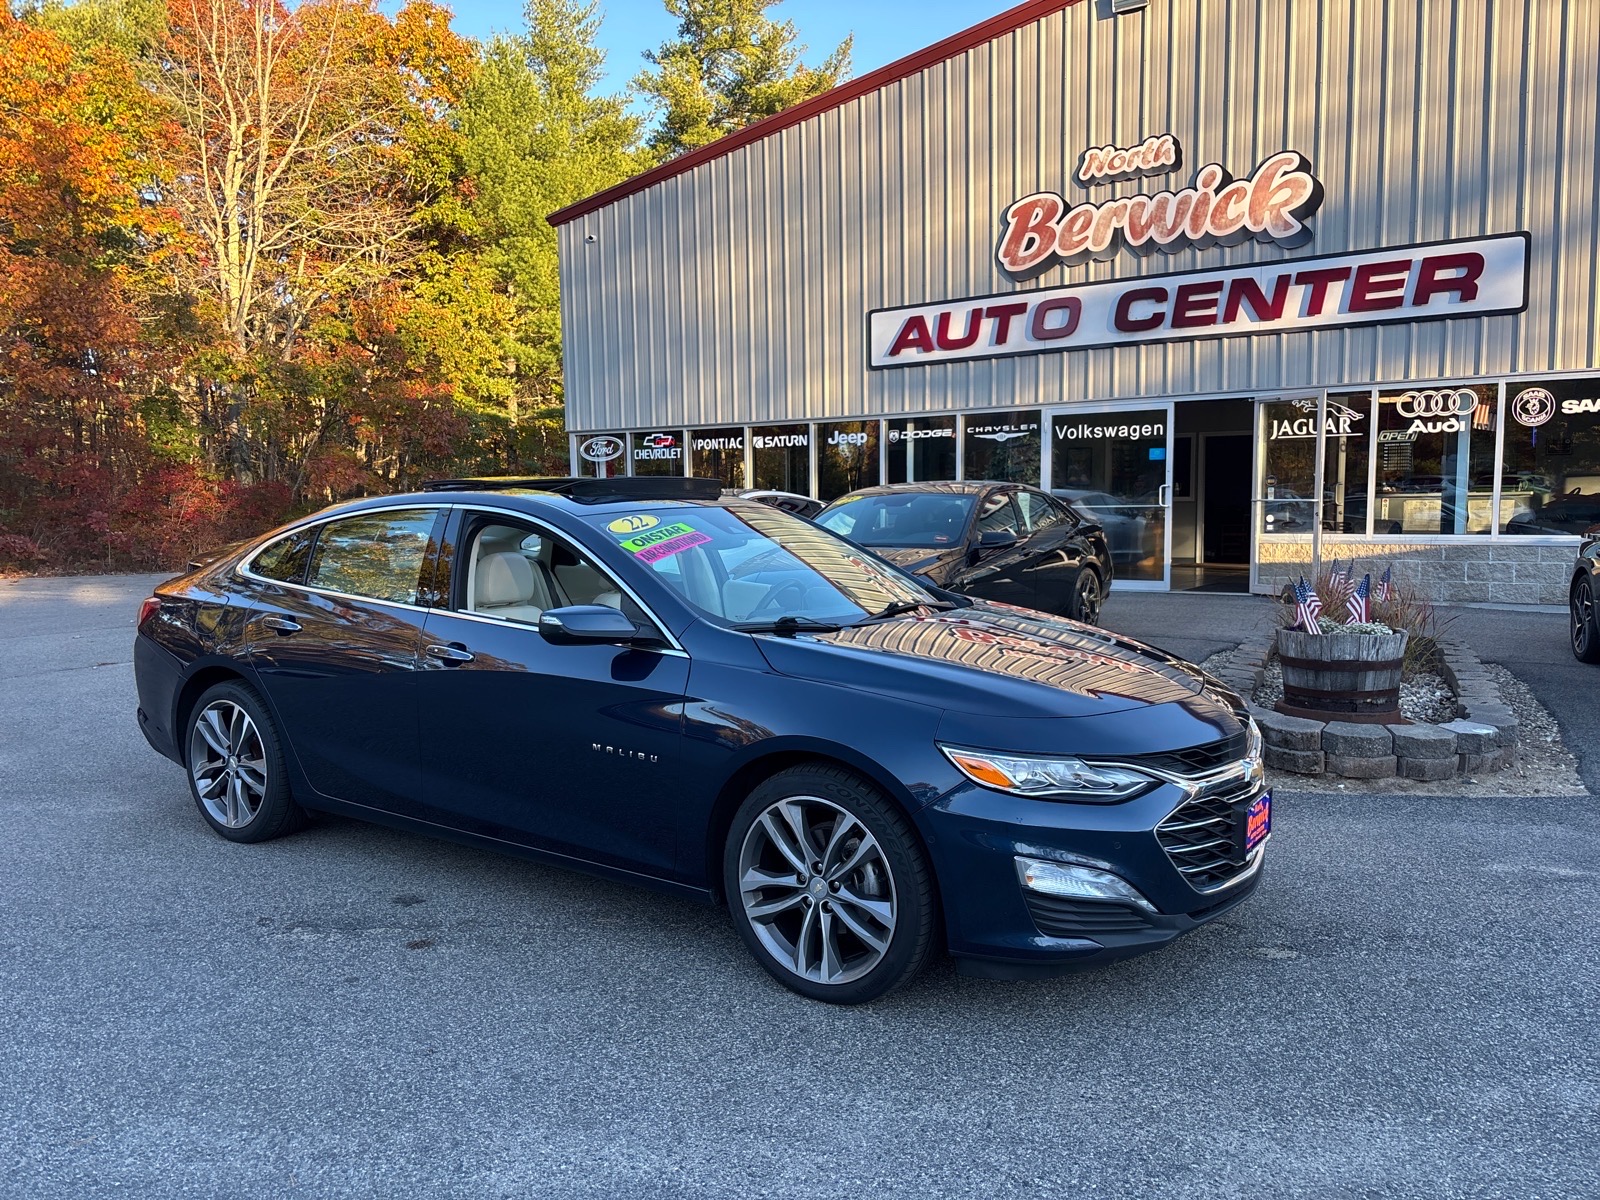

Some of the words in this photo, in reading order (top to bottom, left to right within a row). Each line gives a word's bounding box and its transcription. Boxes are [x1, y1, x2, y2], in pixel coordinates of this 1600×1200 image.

[1080, 134, 1176, 181] North
[998, 150, 1313, 272] Berwick
[888, 297, 1082, 357] AUTO
[1113, 251, 1485, 333] CENTER
[1522, 391, 1546, 401] SAAB
[967, 423, 1037, 434] CHRYSLER
[1055, 423, 1164, 440] Volkswagen
[1270, 417, 1352, 440] JAGUAR
[1406, 418, 1466, 433] Audi
[764, 434, 808, 448] SATURN
[827, 430, 868, 446] Jeep
[900, 429, 953, 439] DODGE
[589, 441, 614, 456] Ford
[697, 437, 743, 450] PONTIAC
[634, 448, 682, 460] CHEVROLET
[621, 515, 650, 531] 22
[631, 525, 685, 548] ONSTAR
[592, 743, 658, 762] MALIBU
